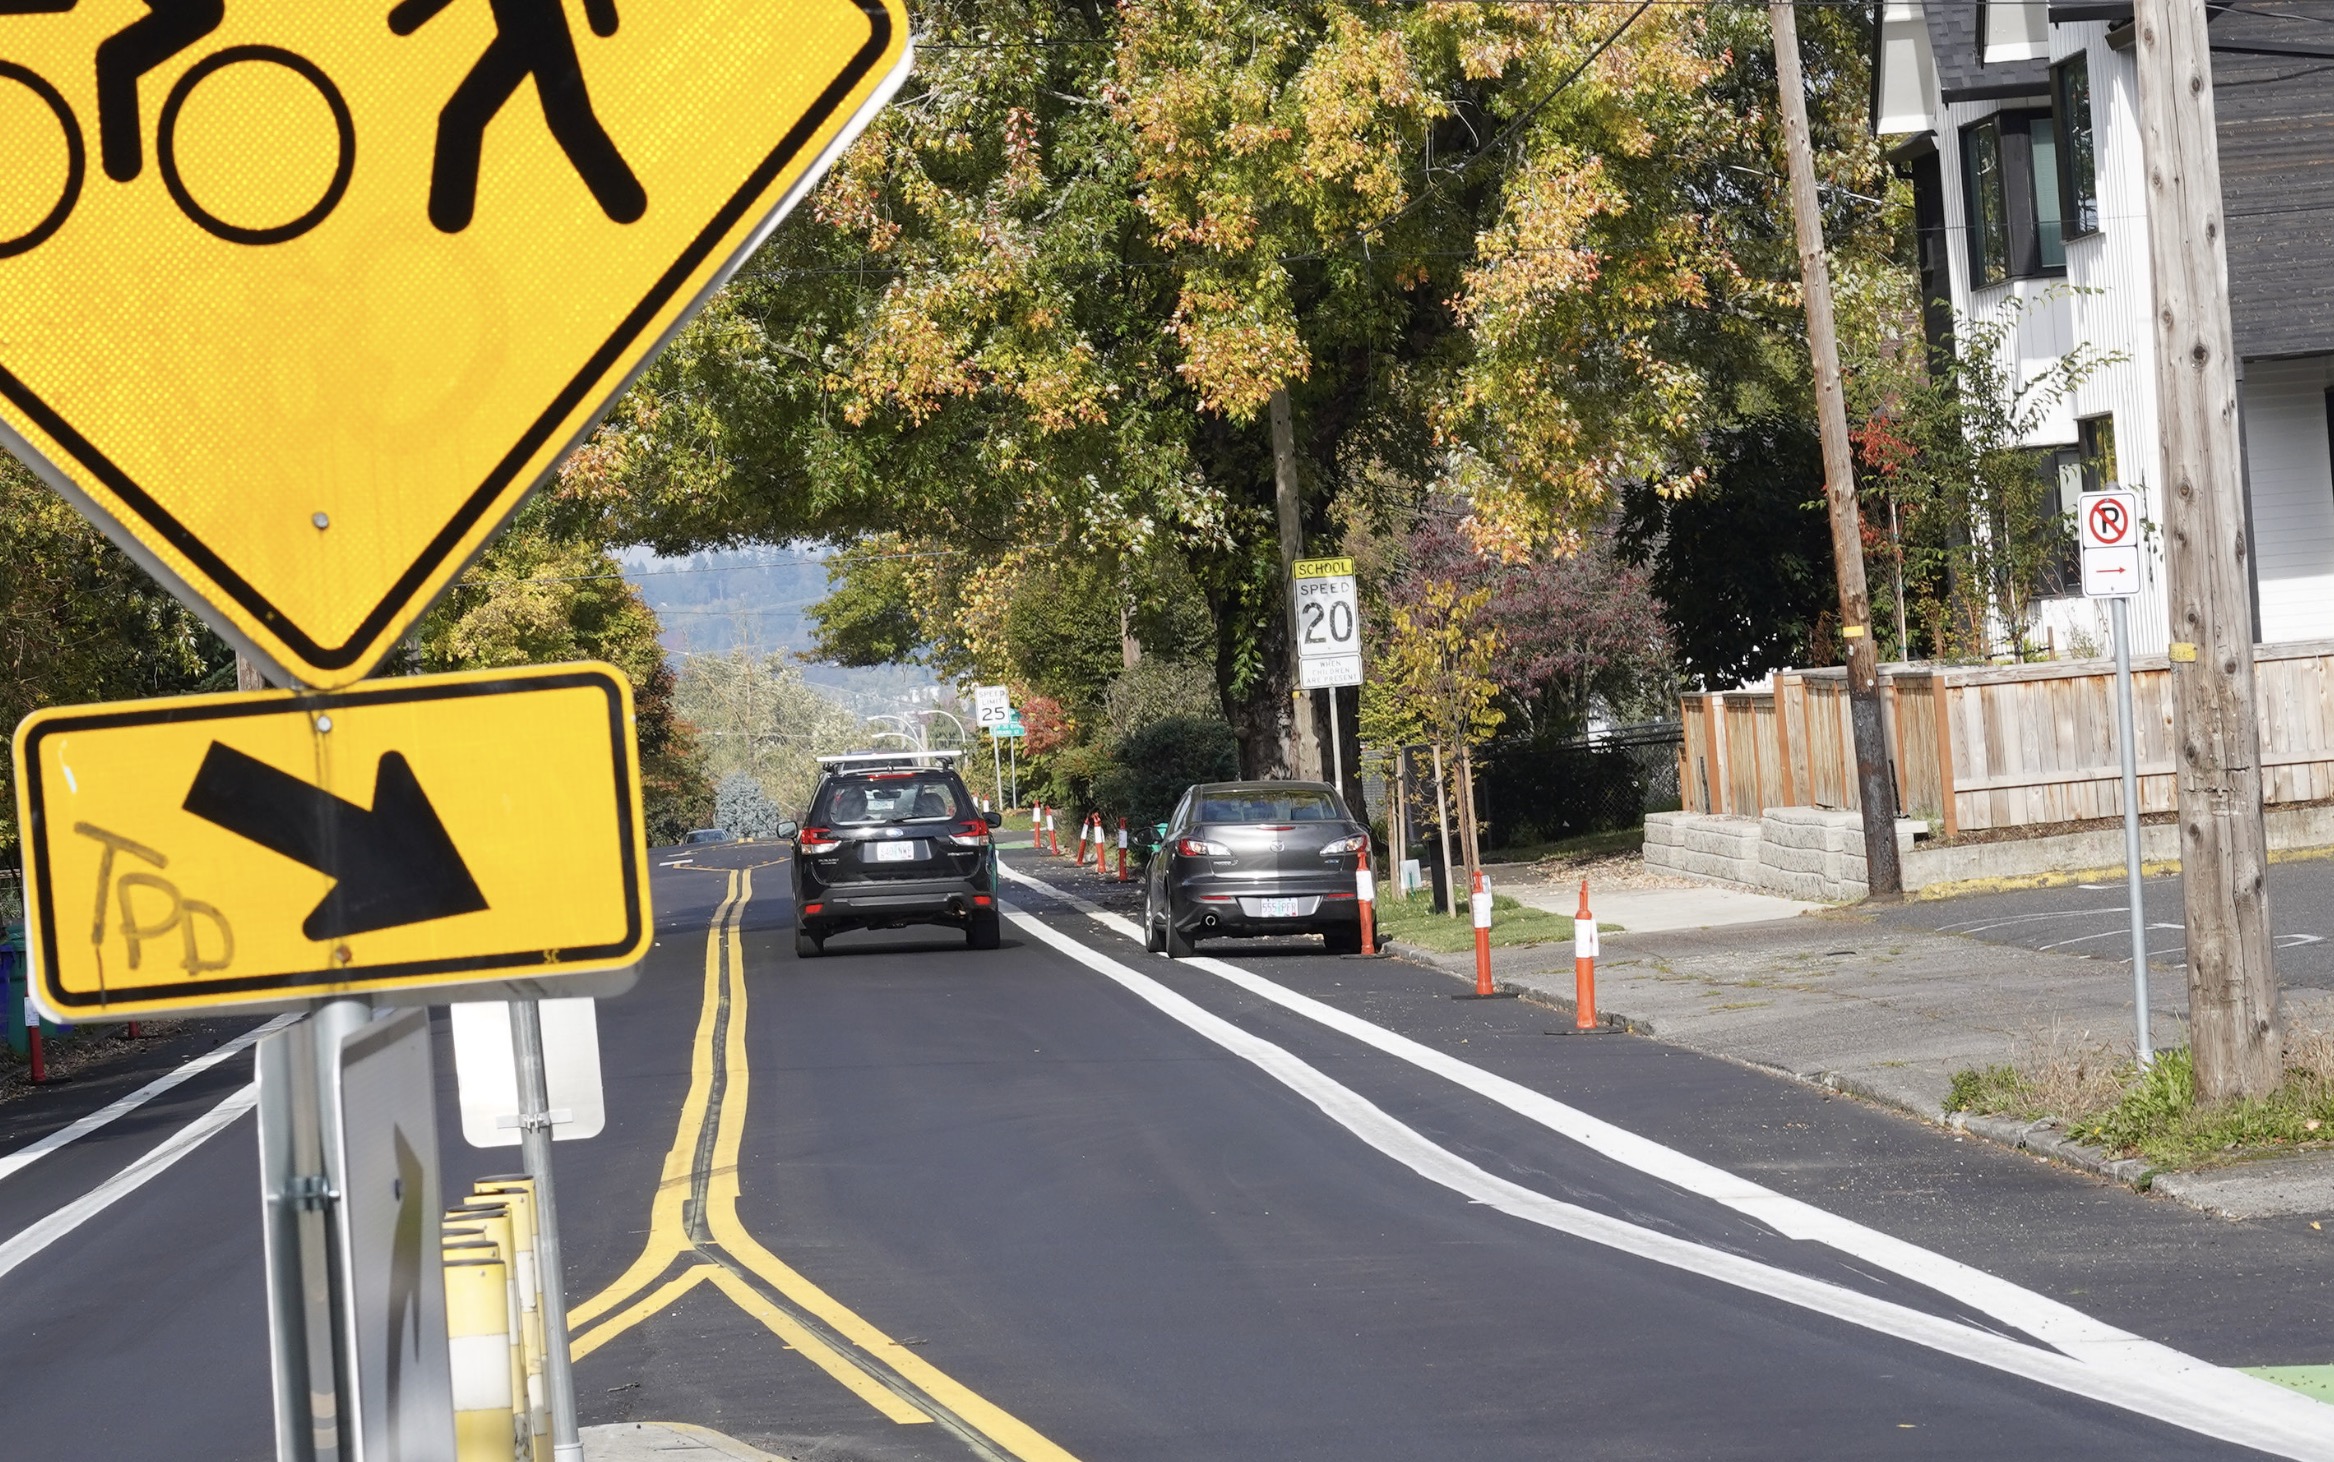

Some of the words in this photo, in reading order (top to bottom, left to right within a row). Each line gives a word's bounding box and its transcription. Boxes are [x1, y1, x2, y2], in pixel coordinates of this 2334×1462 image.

[1299, 563, 1349, 575] SCHOOL
[1300, 582, 1350, 596] SPEED
[1302, 600, 1353, 645] 20
[1320, 660, 1342, 668] WHEN
[1312, 667, 1350, 676] CHILDREN
[1307, 677, 1322, 685] ARE
[1324, 674, 1357, 683] PRESENT
[982, 698, 1002, 706] LIMIT
[982, 706, 1006, 721] 25
[74, 821, 236, 976] TPD
